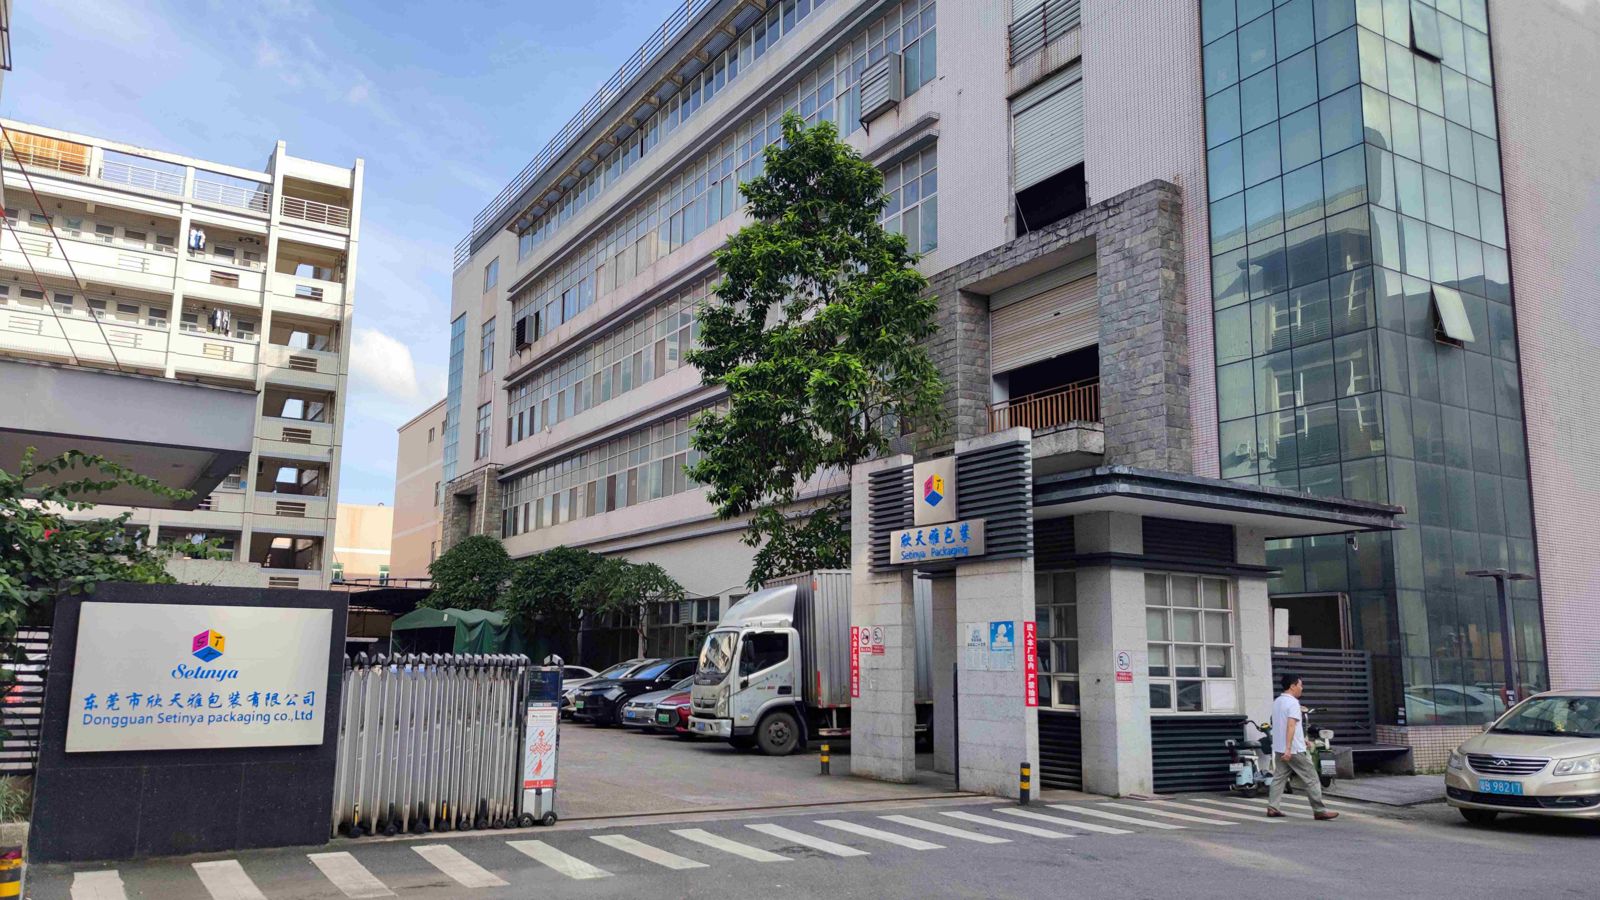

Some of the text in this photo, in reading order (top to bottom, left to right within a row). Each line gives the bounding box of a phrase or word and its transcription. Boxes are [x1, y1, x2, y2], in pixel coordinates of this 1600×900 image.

[900, 522, 973, 548] 欣天雅包装
[931, 544, 969, 558] Packaging
[171, 664, 239, 682] Setinya
[83, 690, 316, 711] 东莞市欣天雅包装有限公司
[82, 713, 153, 728] Dongguan
[157, 712, 204, 726] Setinya
[208, 710, 271, 725] packaging
